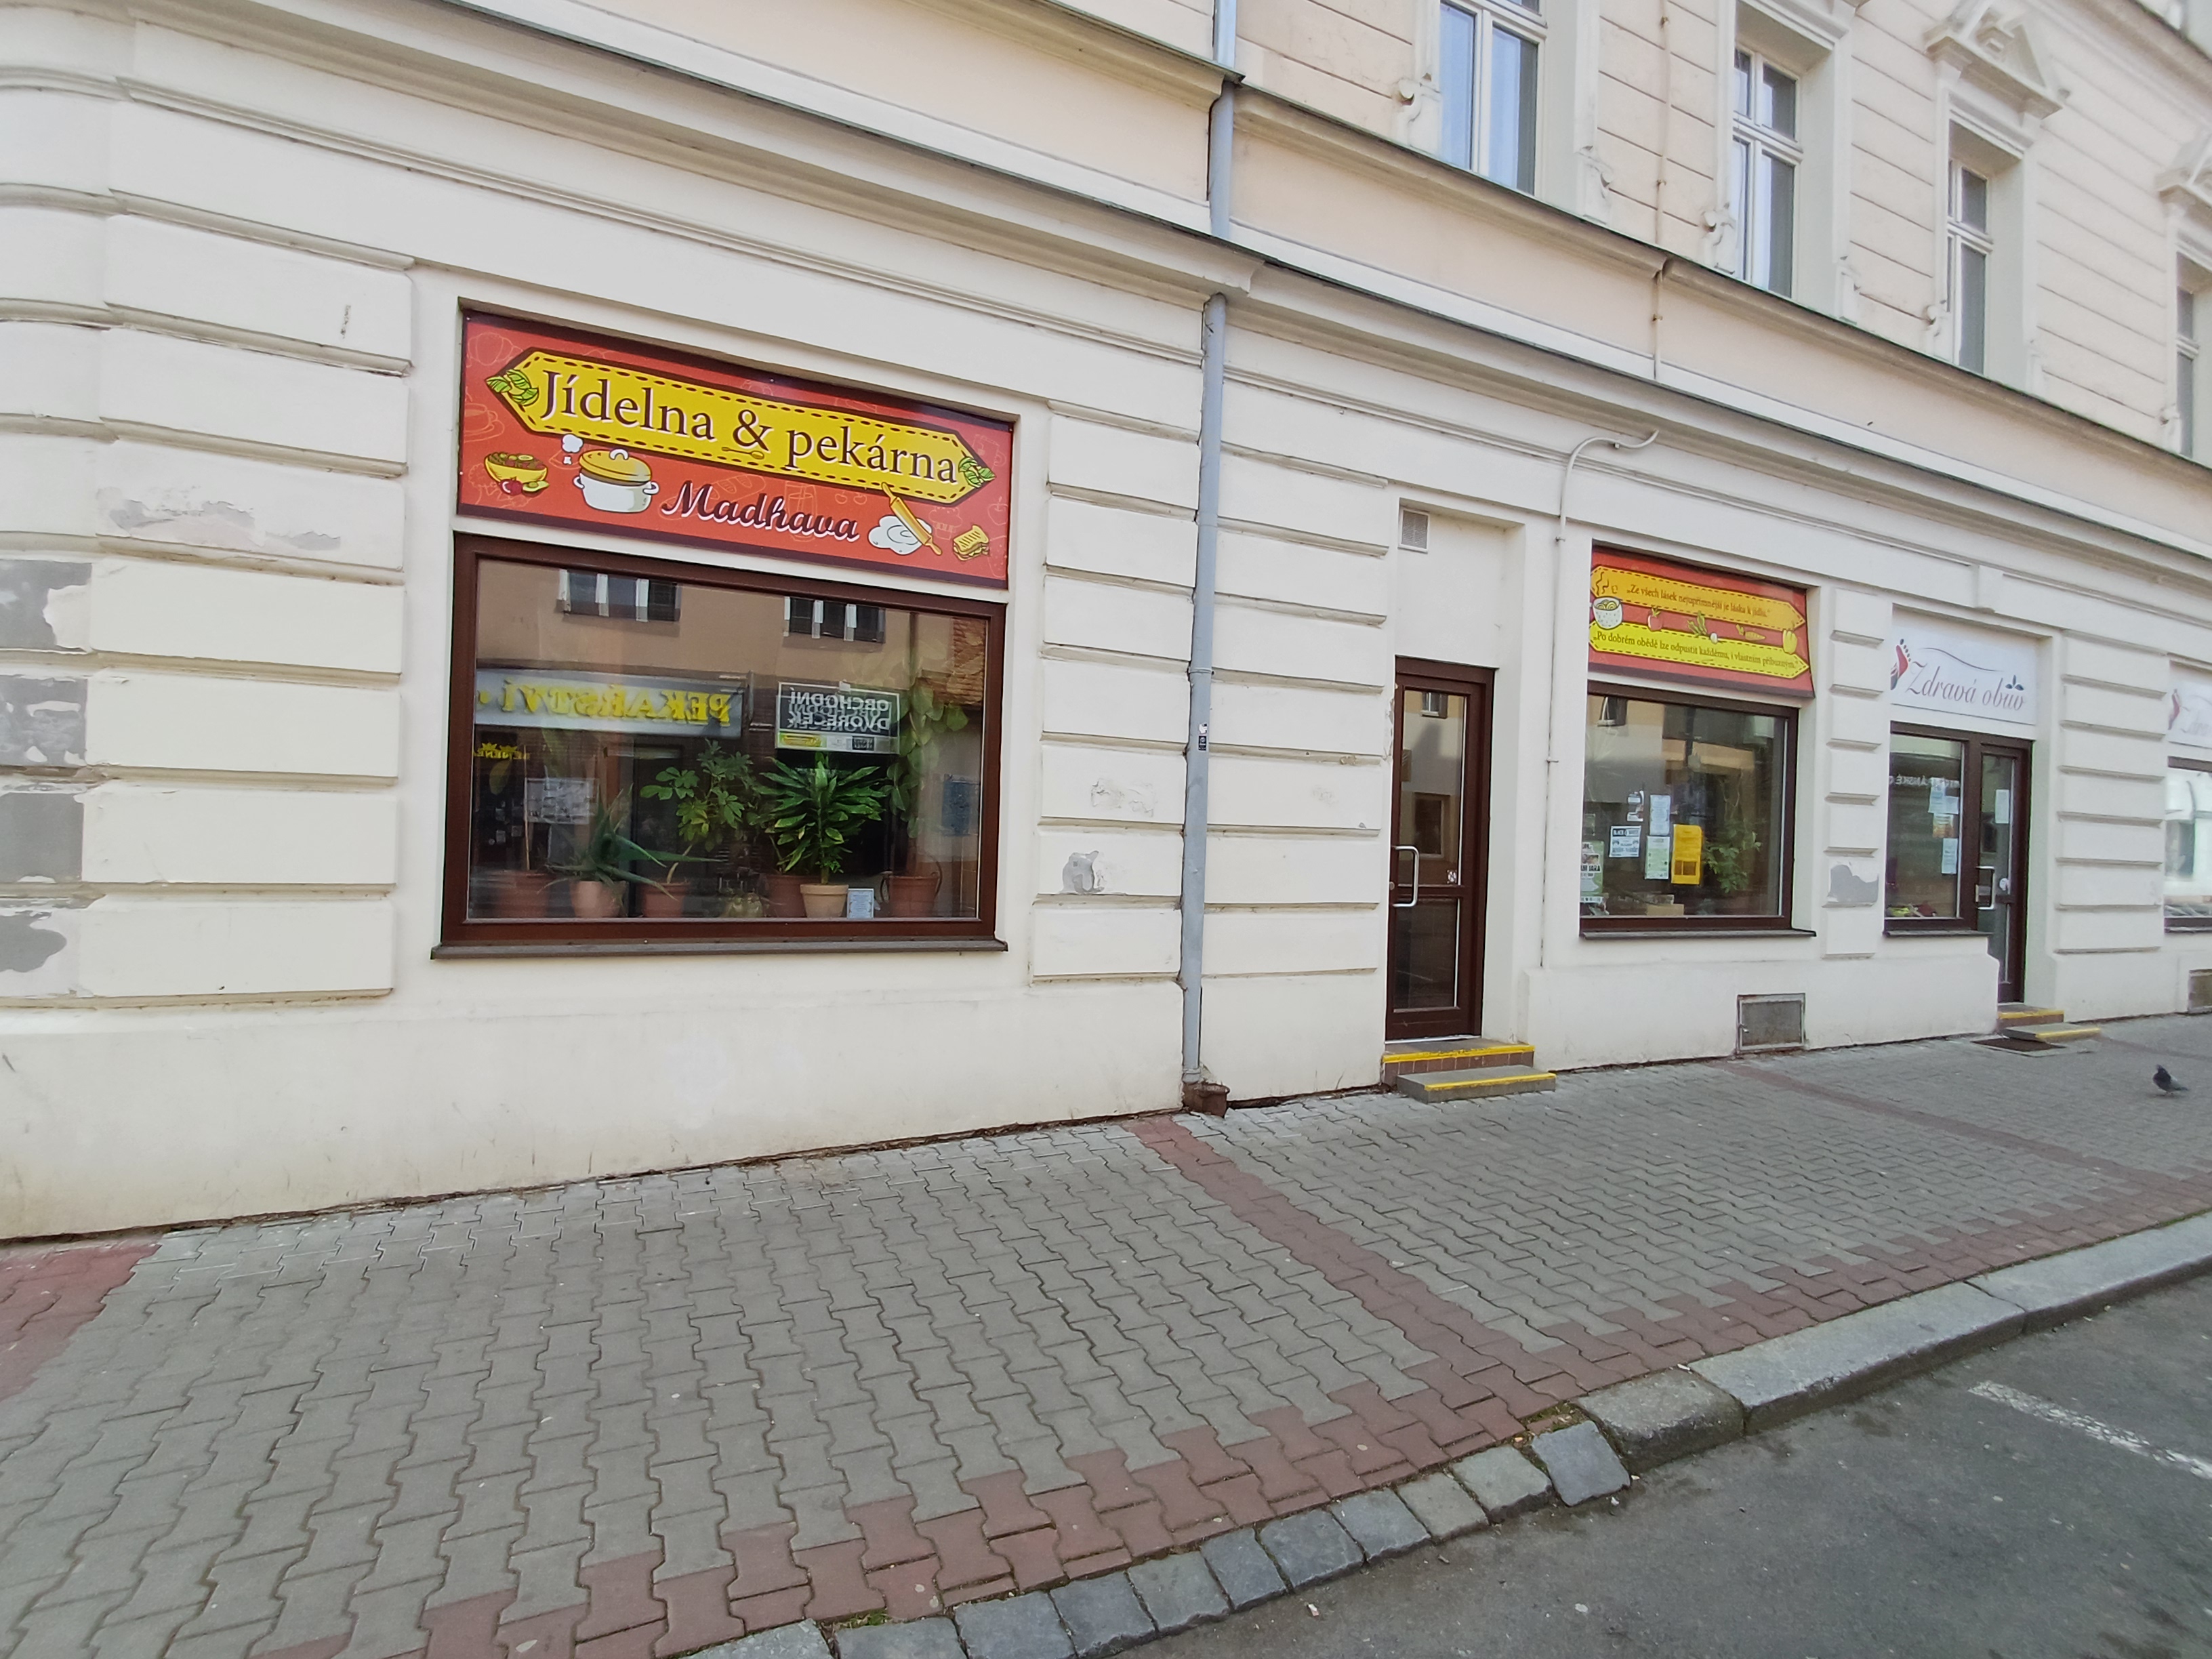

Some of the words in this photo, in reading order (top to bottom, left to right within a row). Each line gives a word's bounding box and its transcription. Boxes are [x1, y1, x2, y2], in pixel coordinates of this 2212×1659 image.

[540, 369, 717, 443] Jídelna
[733, 409, 775, 453] &
[785, 426, 958, 485] pekárna
[661, 480, 860, 542] Madhava
[1641, 587, 1659, 598] všech
[1608, 634, 1635, 645] dobrém
[1637, 638, 1658, 649] obědě
[1660, 640, 1669, 649] lze
[1671, 642, 1699, 655] odpustit
[1906, 661, 1977, 703] Zdravá
[1982, 677, 2024, 711] obuv
